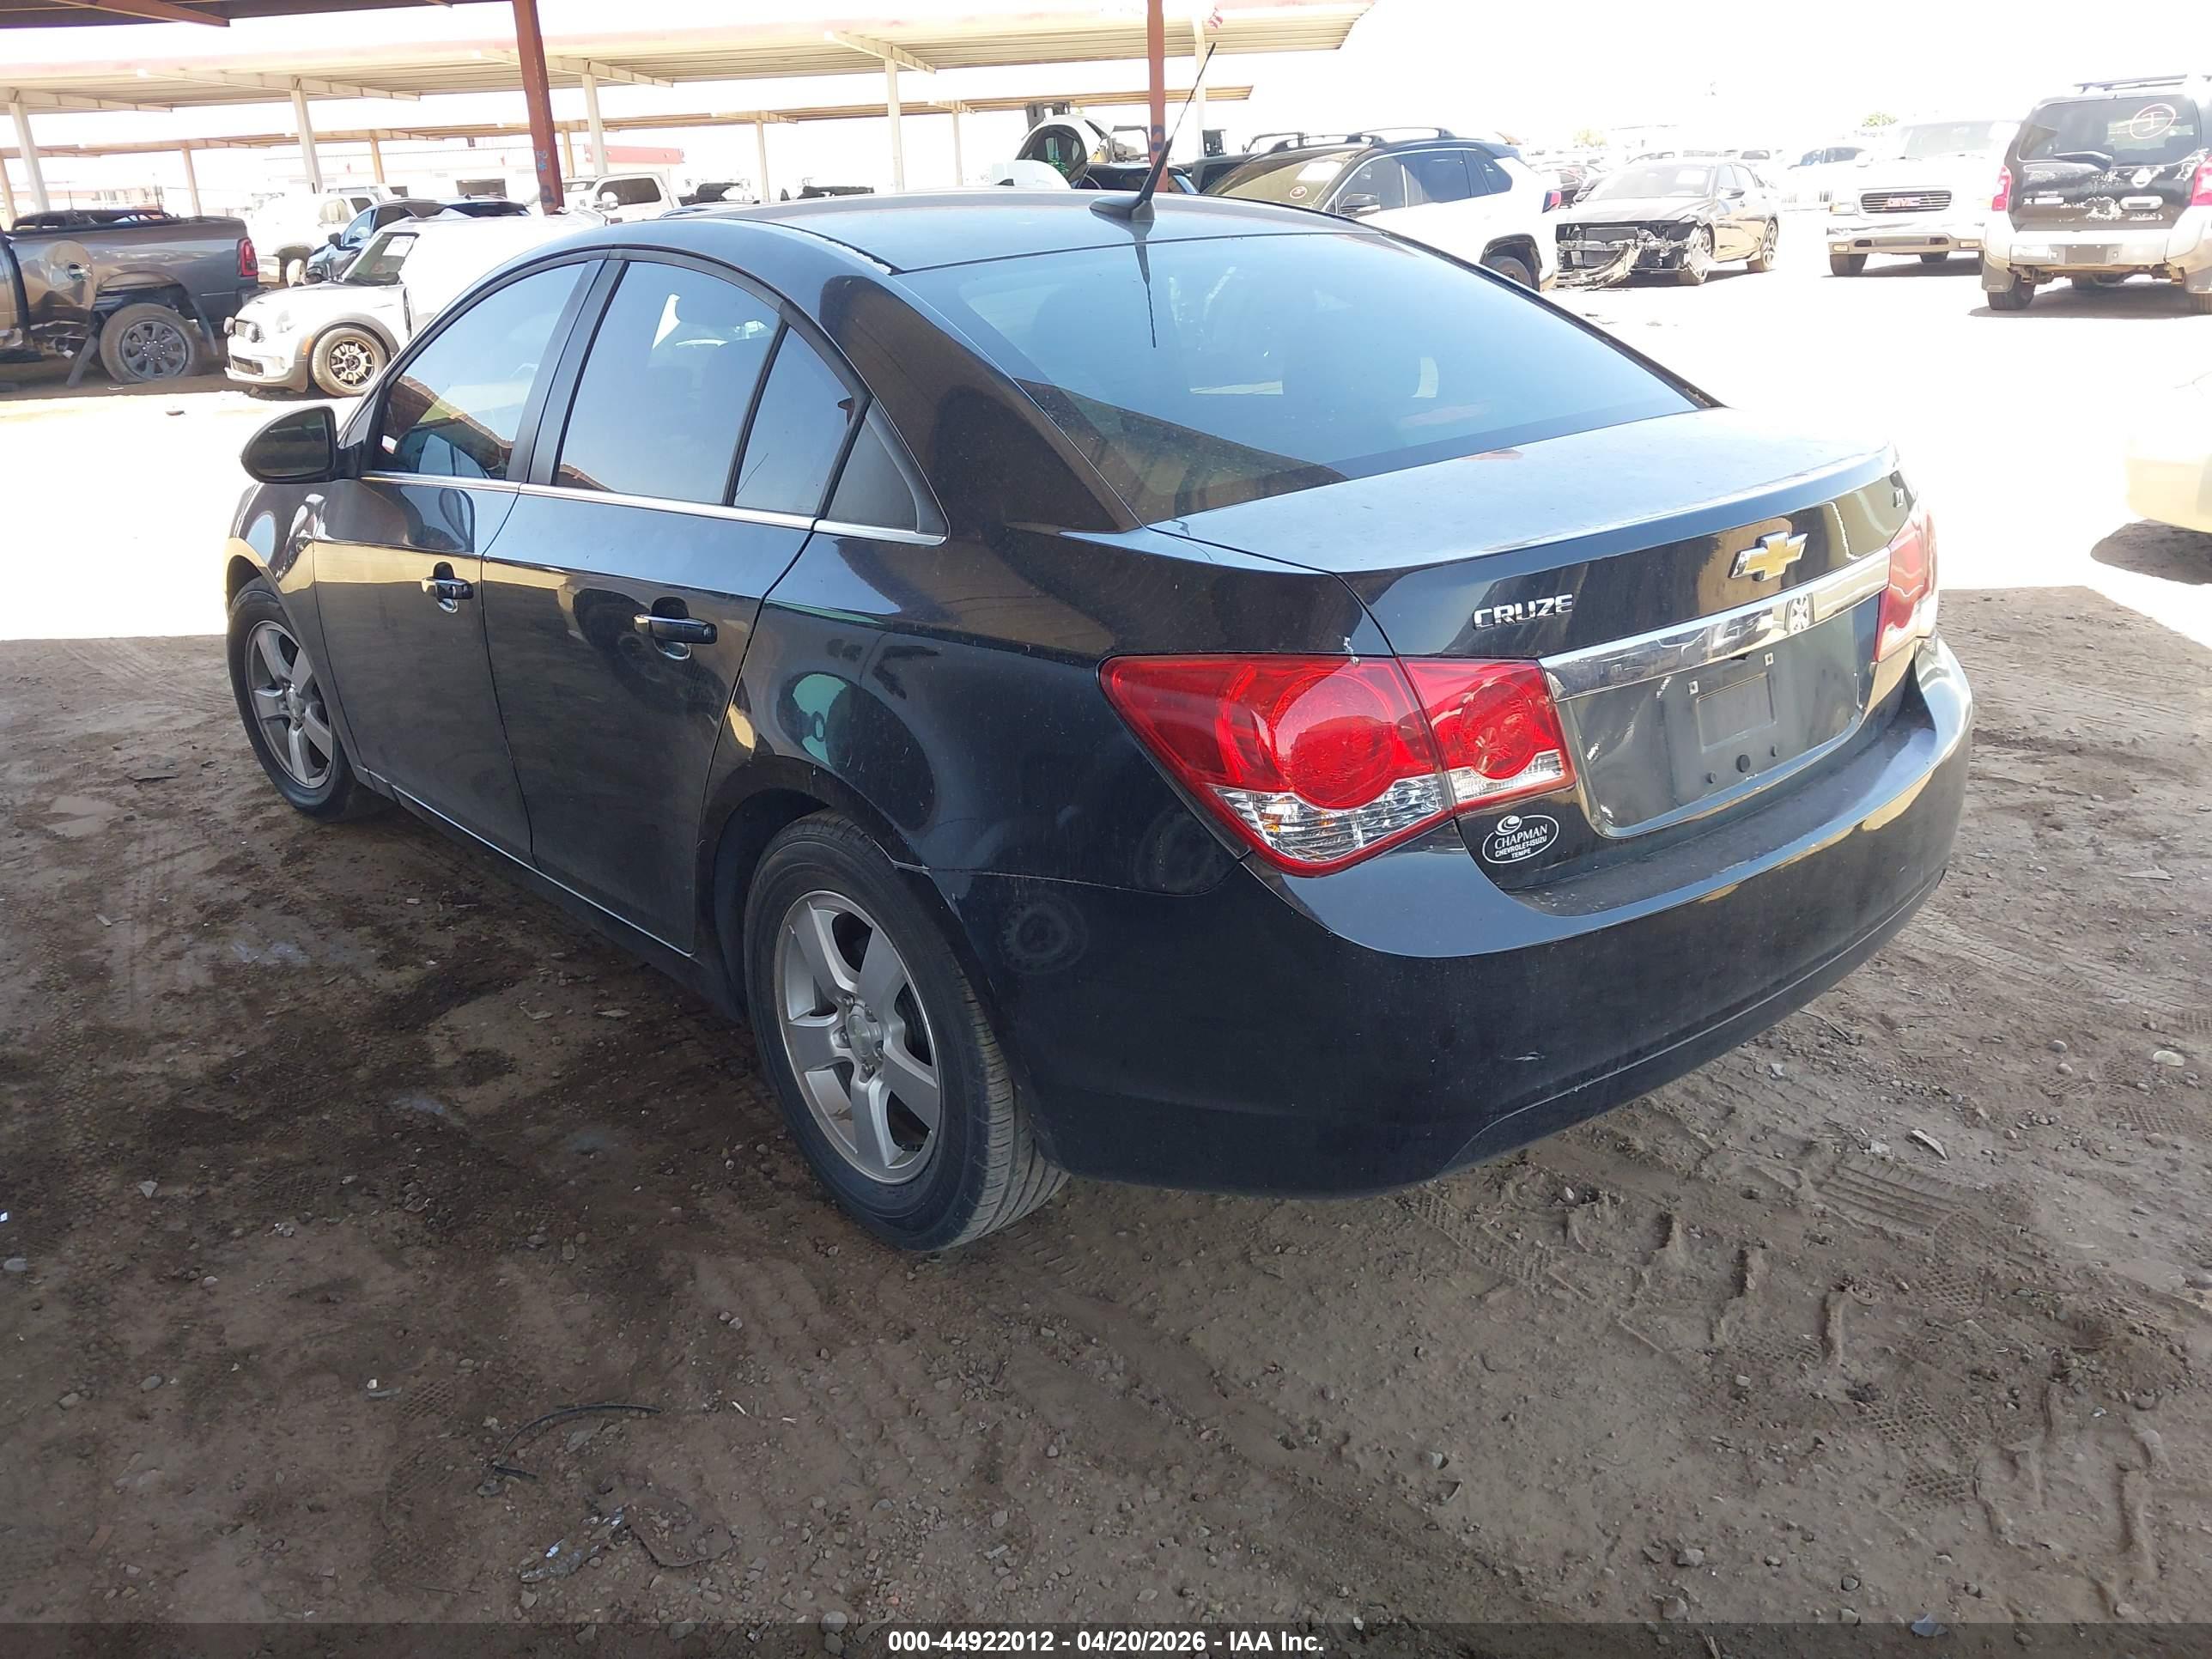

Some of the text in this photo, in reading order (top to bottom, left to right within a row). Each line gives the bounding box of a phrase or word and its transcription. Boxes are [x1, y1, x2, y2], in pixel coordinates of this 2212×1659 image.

[1473, 593, 1573, 629] CRUZE
[1494, 823, 1548, 850] CHAPMAN
[1511, 848, 1532, 859] TEMPE
